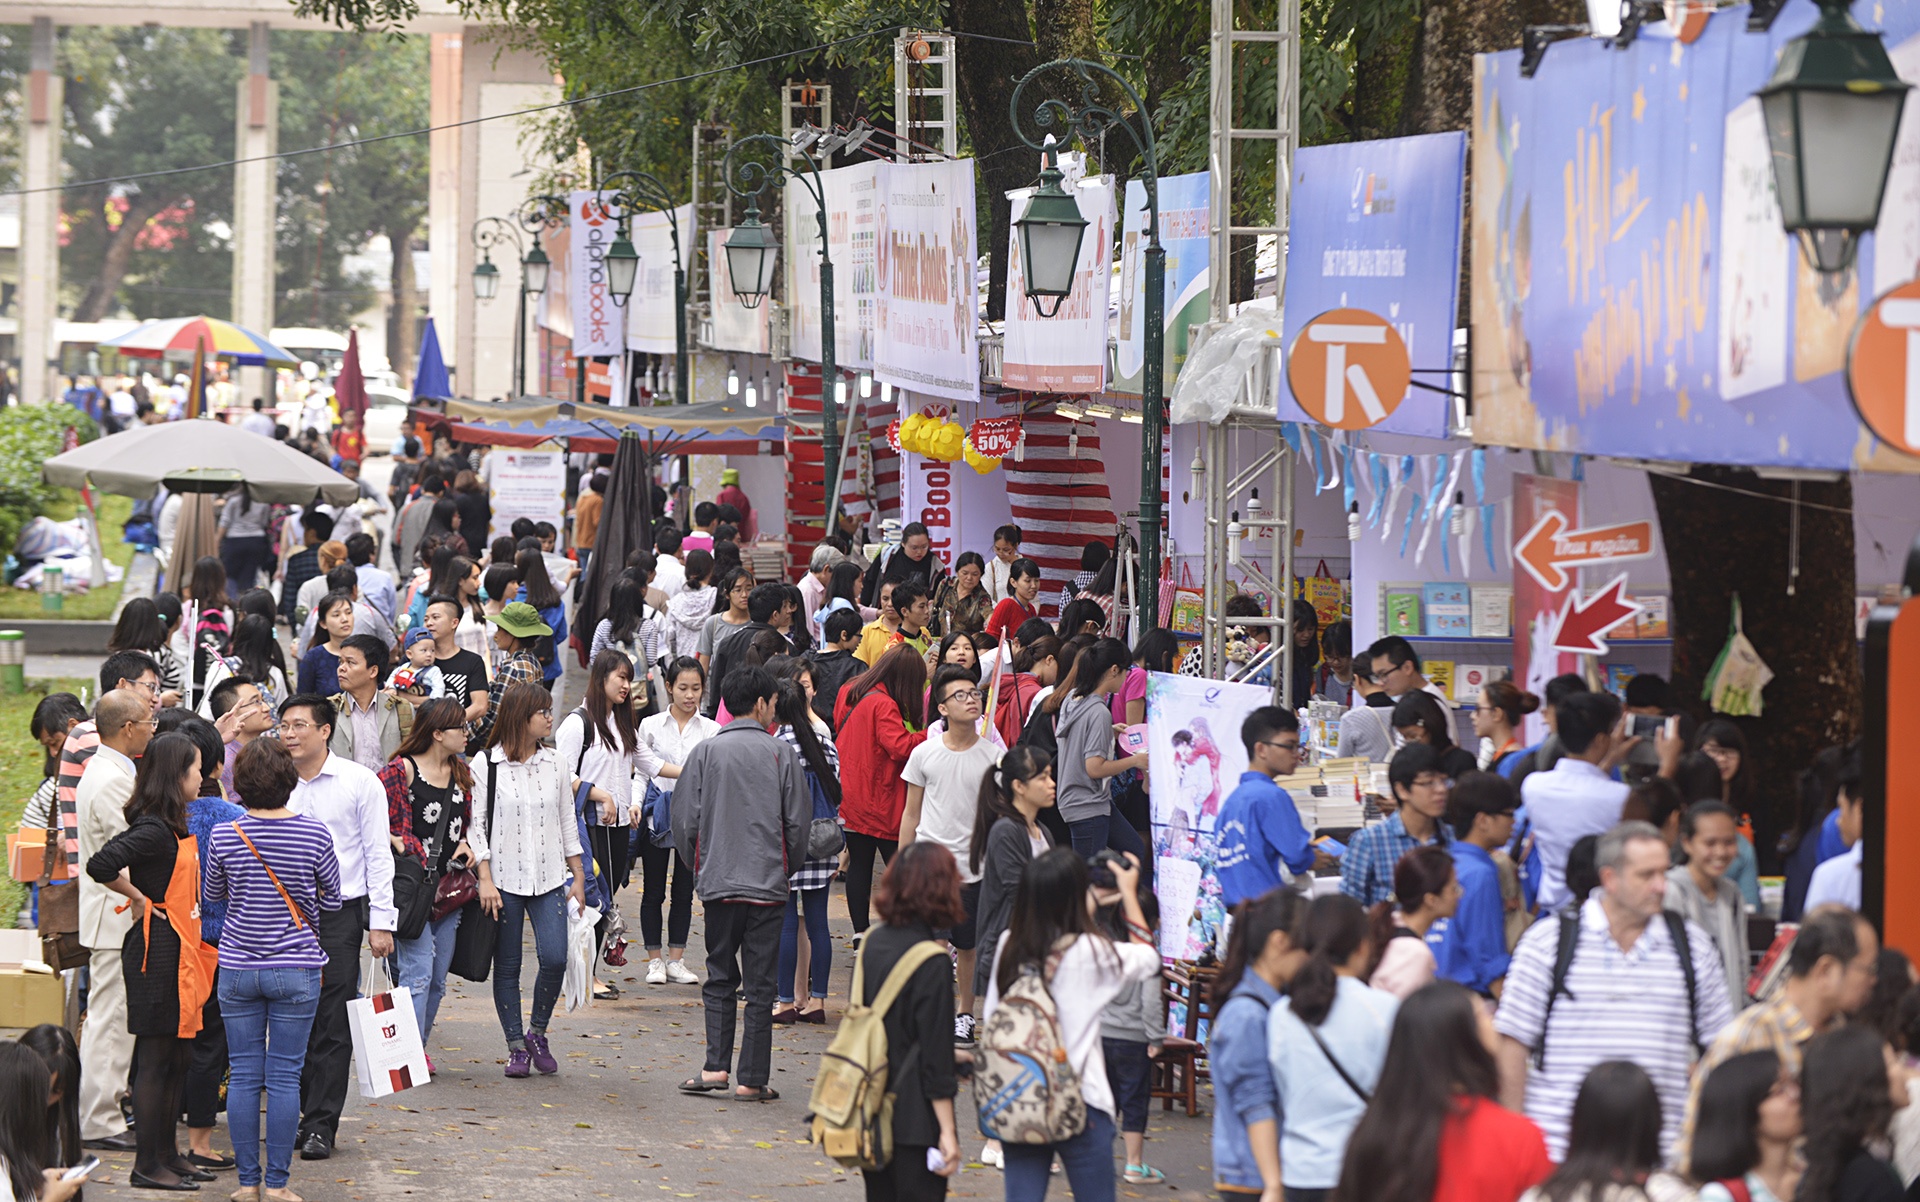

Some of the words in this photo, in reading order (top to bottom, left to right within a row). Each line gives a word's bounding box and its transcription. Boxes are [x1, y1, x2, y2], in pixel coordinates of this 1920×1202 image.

[919, 231, 948, 305] Books
[978, 434, 1012, 451] 50%
[920, 457, 951, 527] Book
[1554, 537, 1587, 556] Thu
[1589, 534, 1639, 557] ngân
